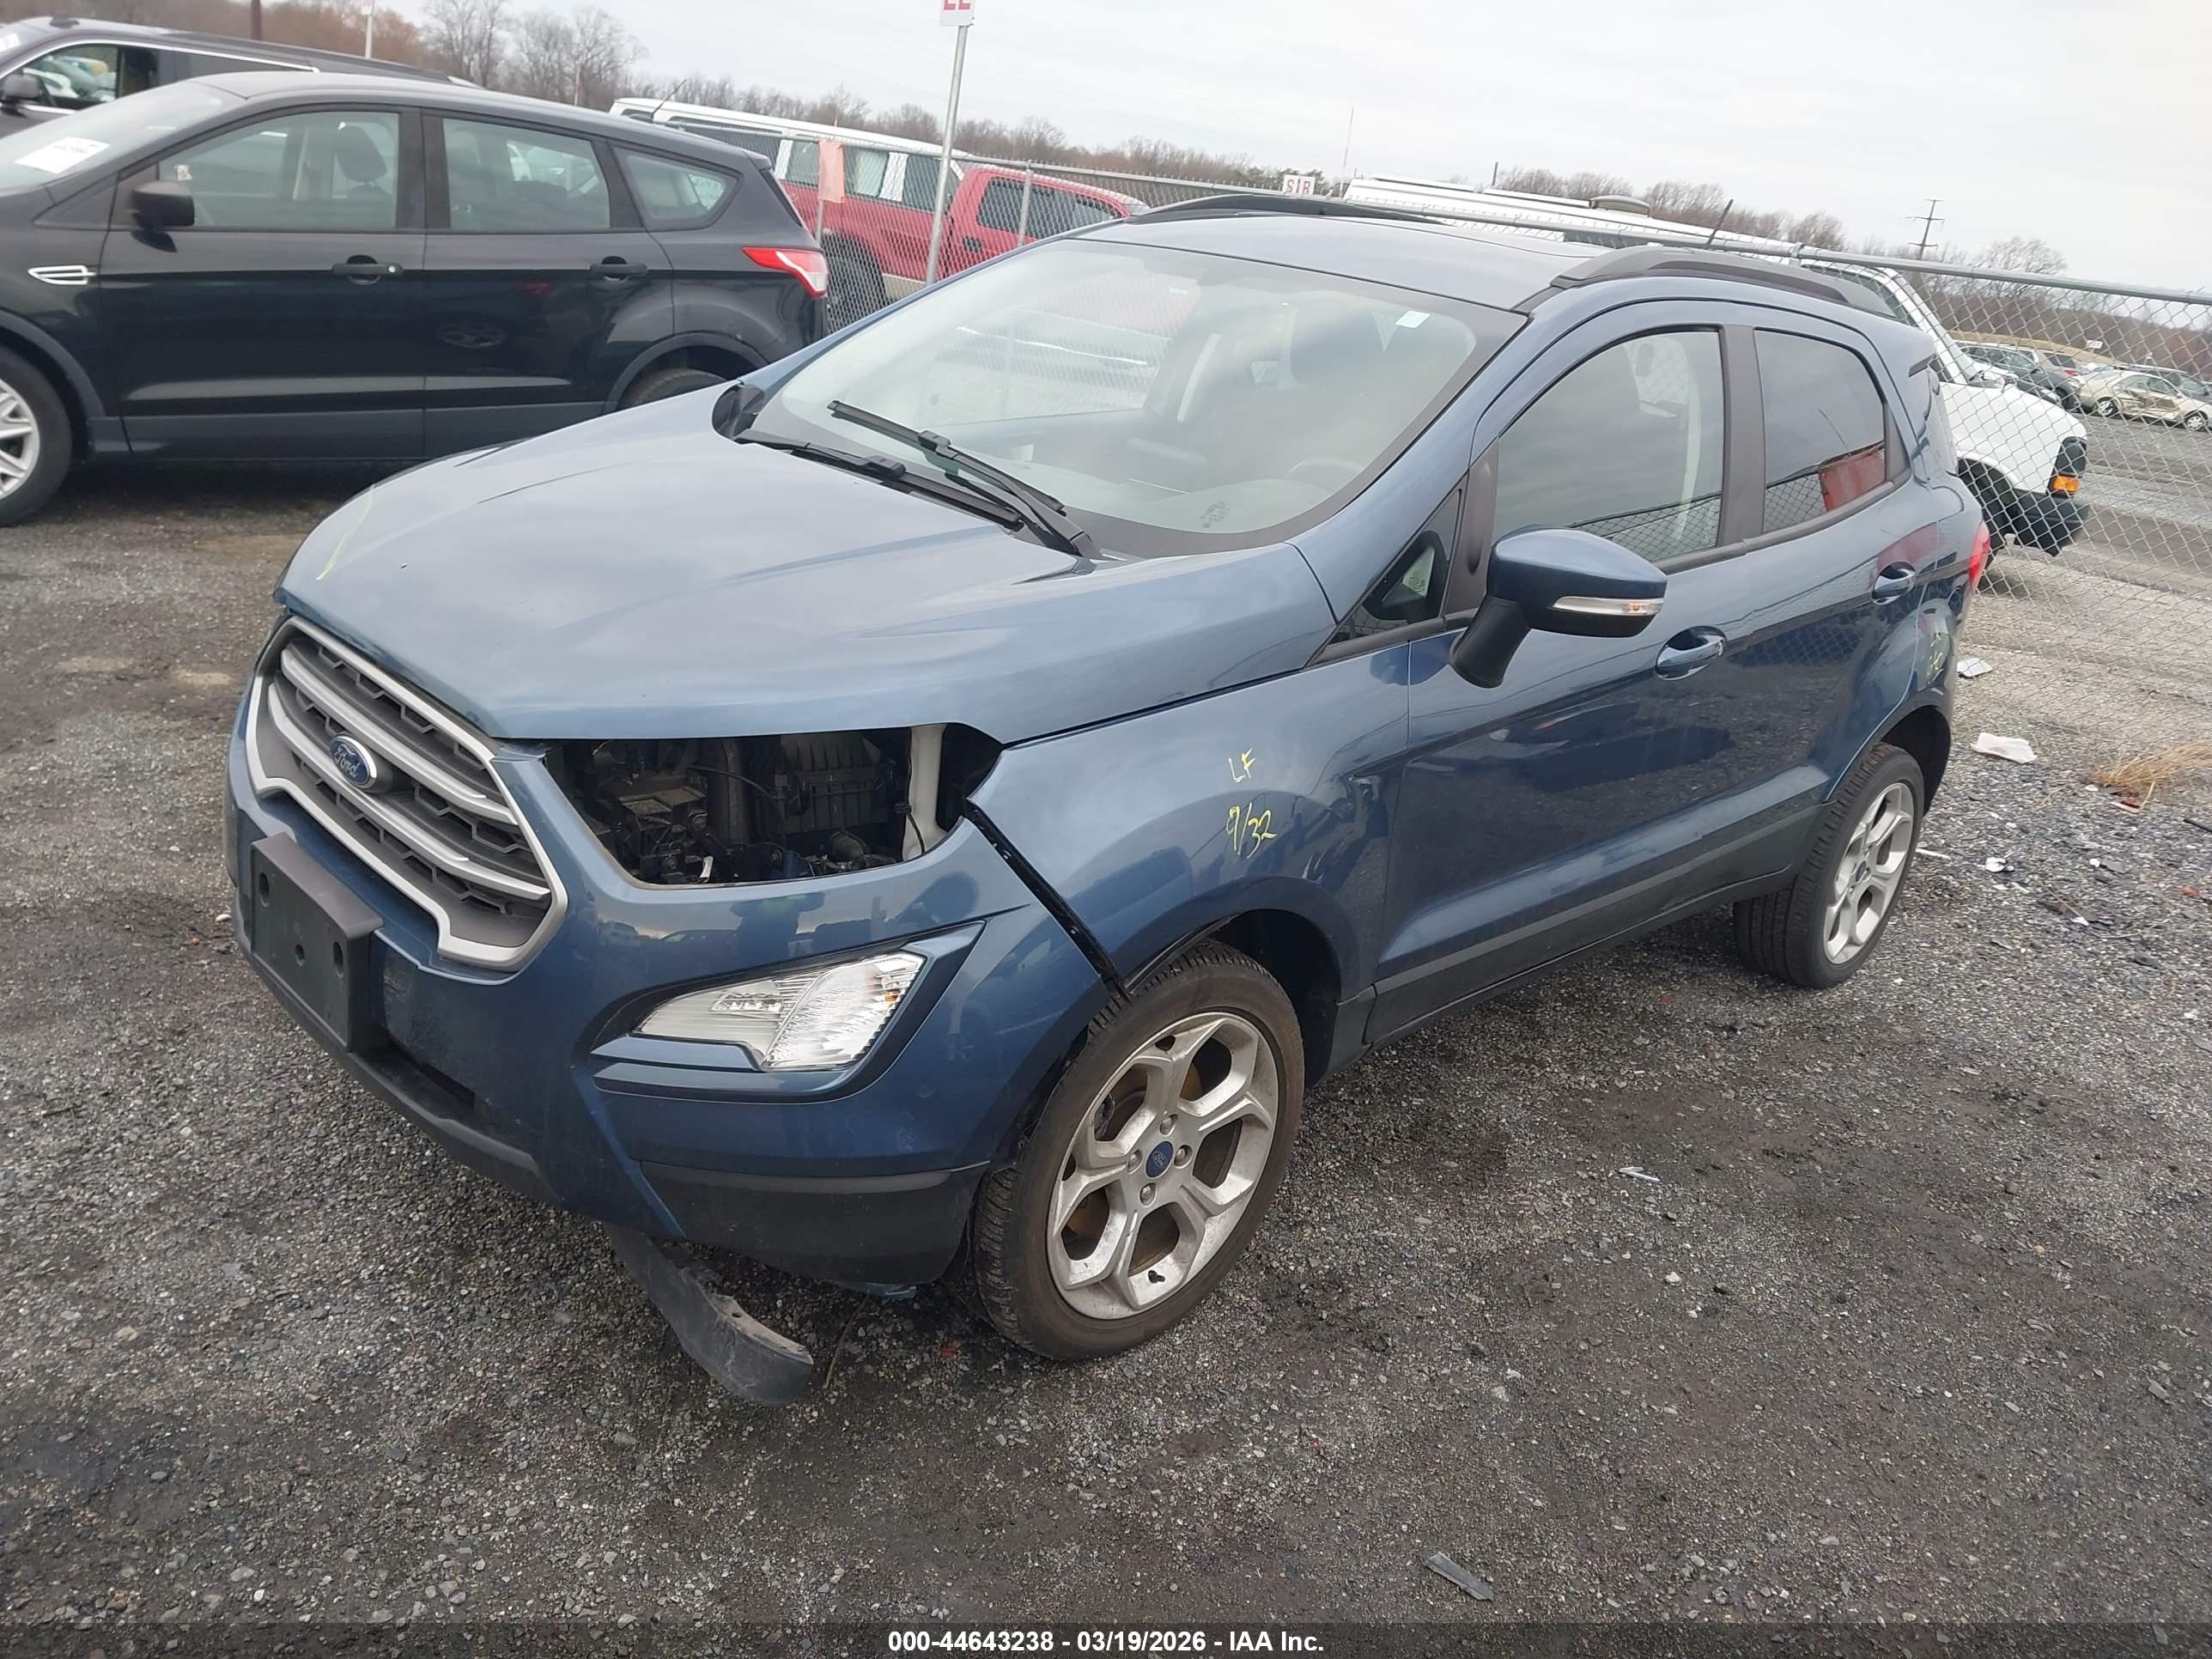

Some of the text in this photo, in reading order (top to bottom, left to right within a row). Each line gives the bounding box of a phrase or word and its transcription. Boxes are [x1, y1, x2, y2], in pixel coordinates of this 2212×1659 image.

[334, 744, 361, 778] Ford
[1228, 747, 1256, 783] LF
[1225, 801, 1279, 859] 9/32
